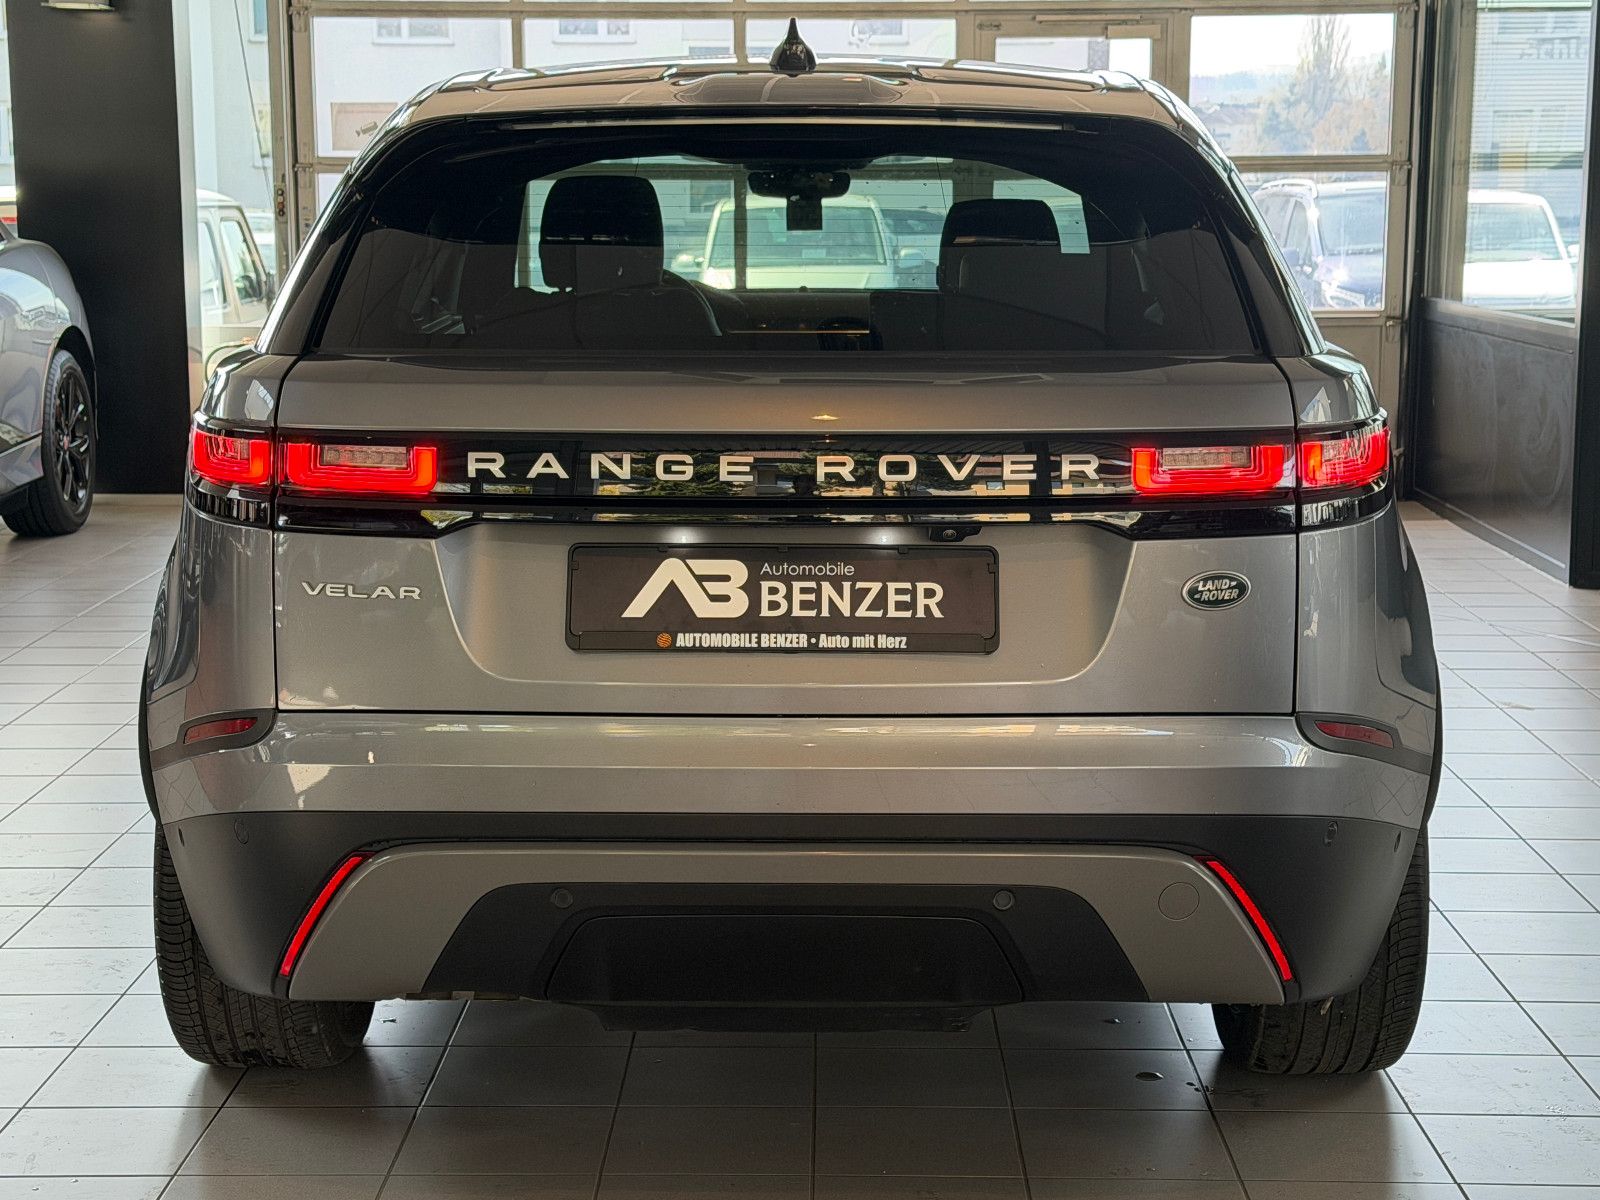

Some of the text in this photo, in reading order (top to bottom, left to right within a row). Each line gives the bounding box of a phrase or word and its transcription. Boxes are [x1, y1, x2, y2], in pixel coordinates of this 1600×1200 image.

[467, 451, 1100, 482] RANGE ROVER
[760, 562, 855, 576] Automobile
[301, 581, 421, 600] VELAR
[620, 557, 750, 618] AB
[759, 580, 945, 618] BENZER
[675, 632, 908, 650] AUTOMOBILE BENZER Auto mit Herz
